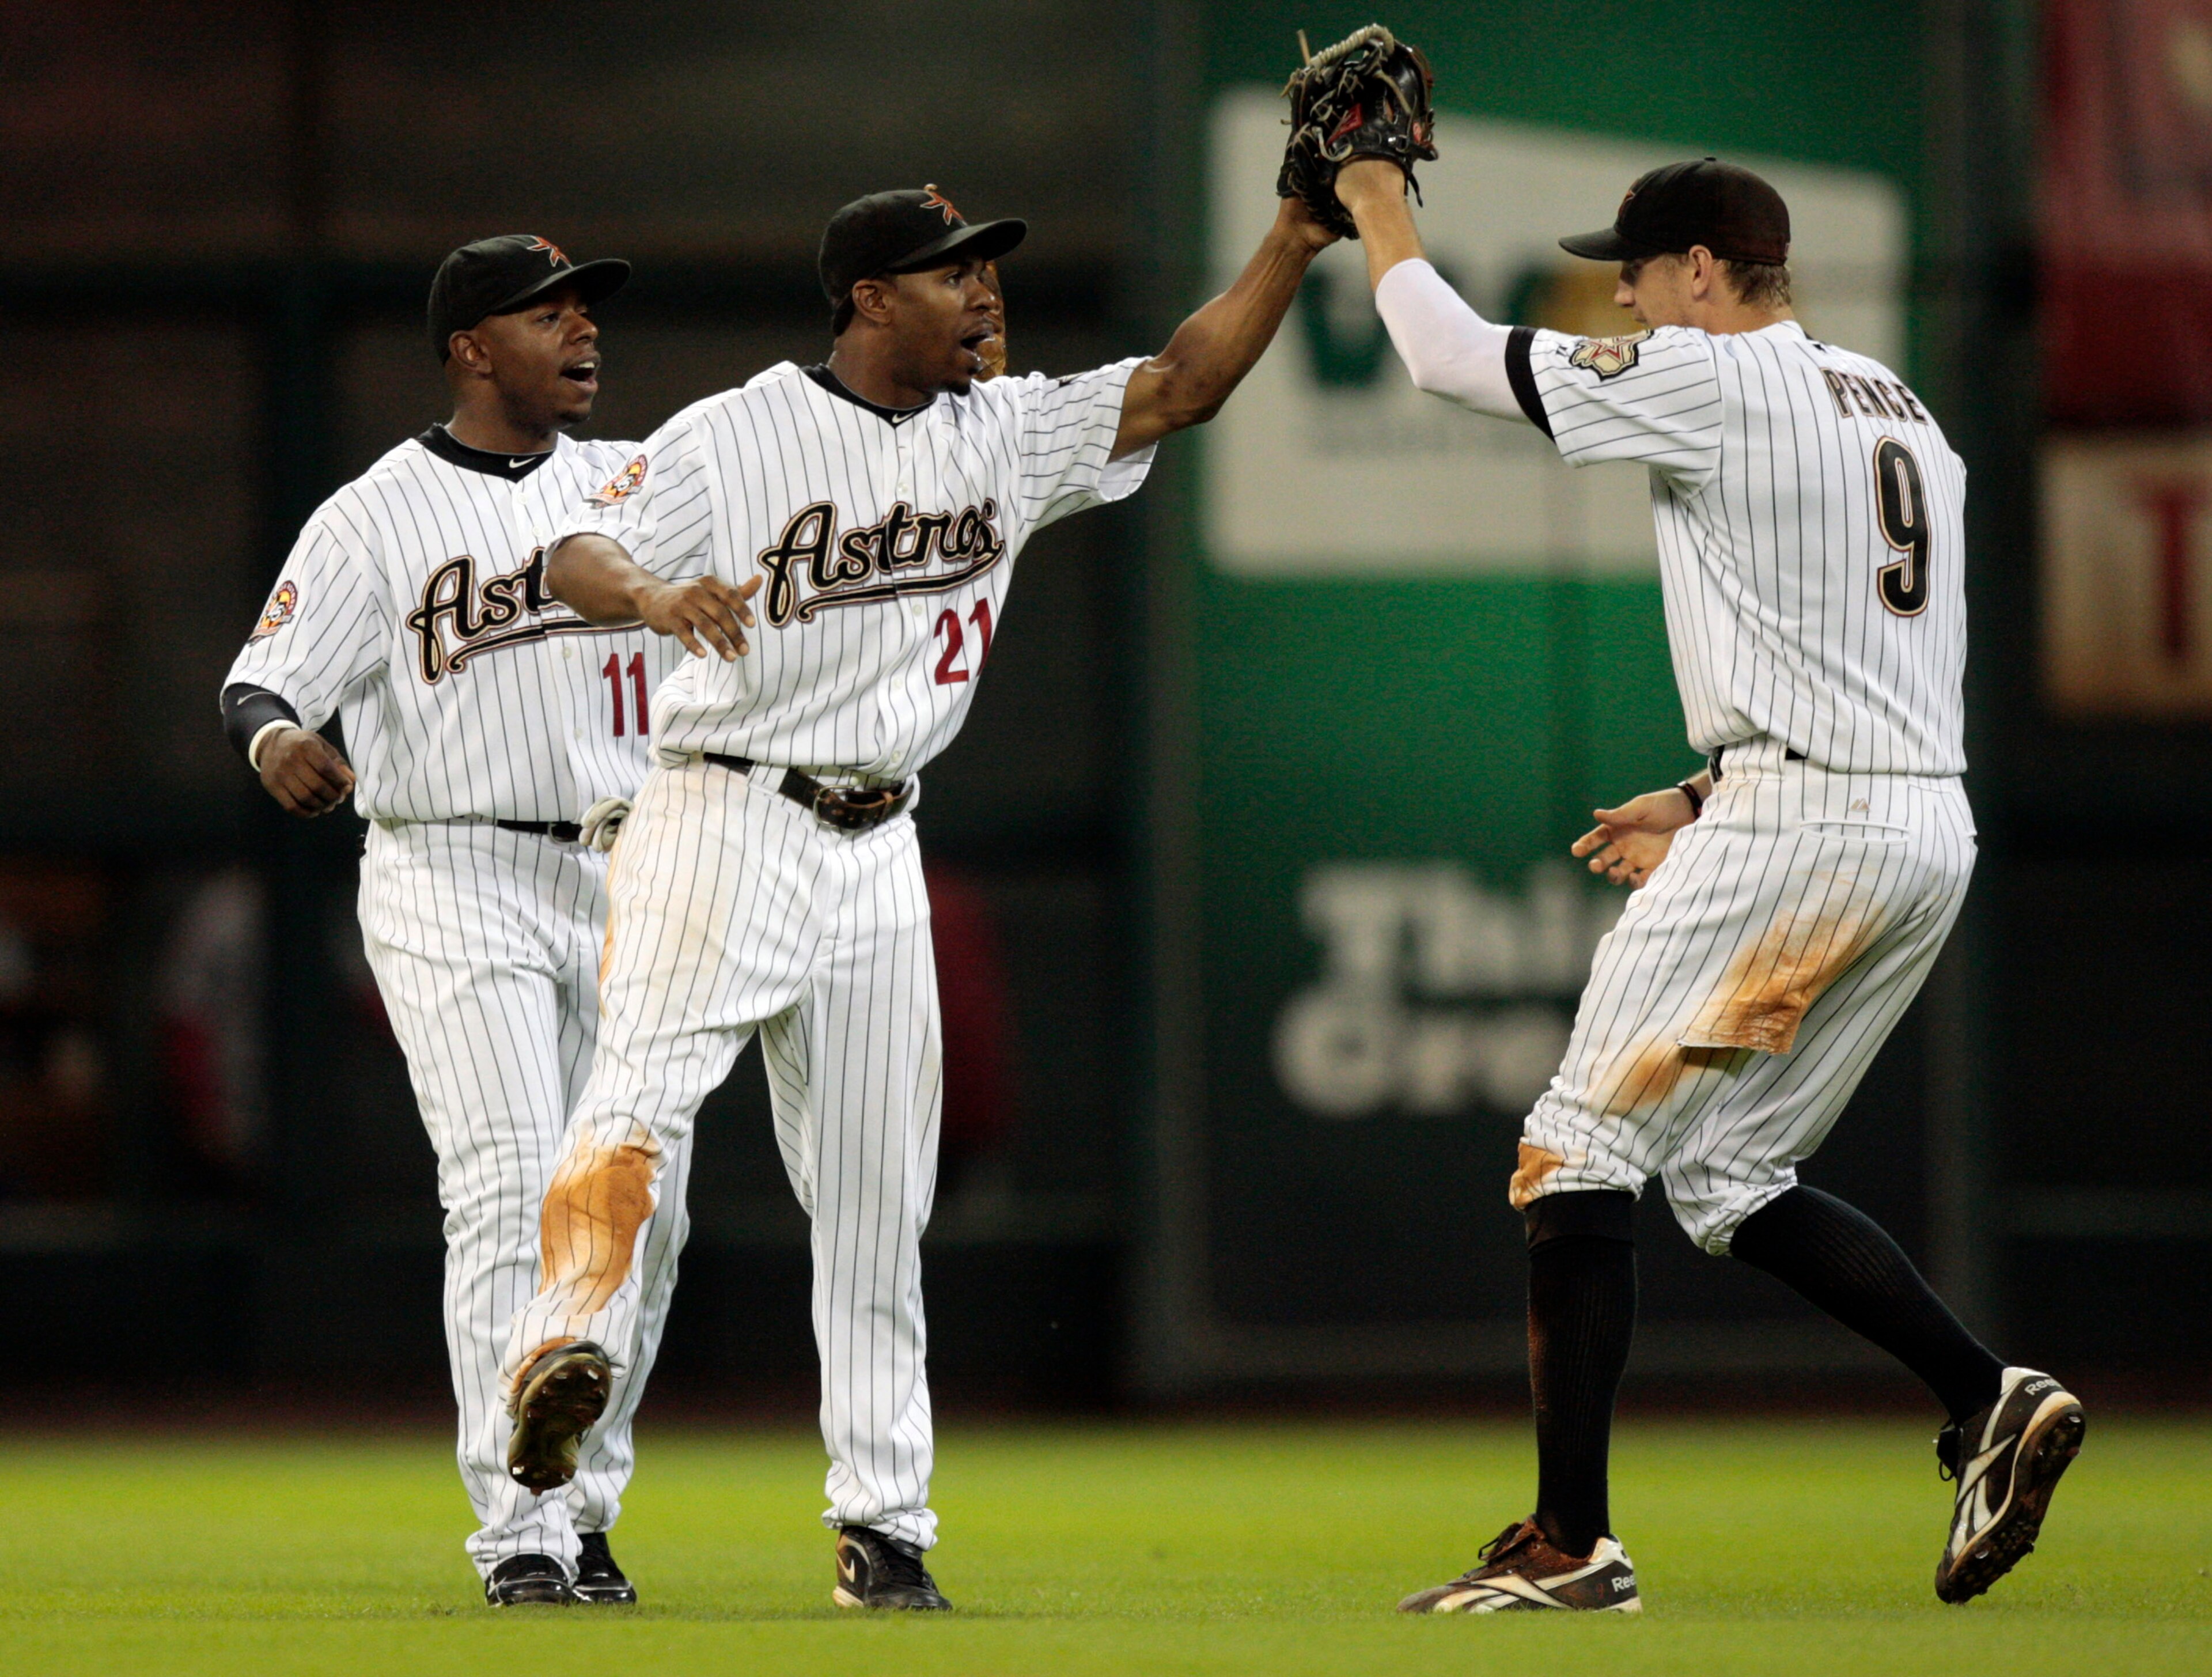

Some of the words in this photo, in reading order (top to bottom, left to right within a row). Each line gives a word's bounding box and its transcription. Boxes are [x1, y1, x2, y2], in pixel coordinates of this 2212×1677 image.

[1819, 366, 1929, 426] PENCE
[757, 497, 1005, 628] Astros
[1874, 436, 1931, 617] 9
[406, 547, 566, 684] Ast
[933, 597, 992, 686] 21
[602, 652, 649, 737] 11
[1612, 1575, 1636, 1592] Ree
